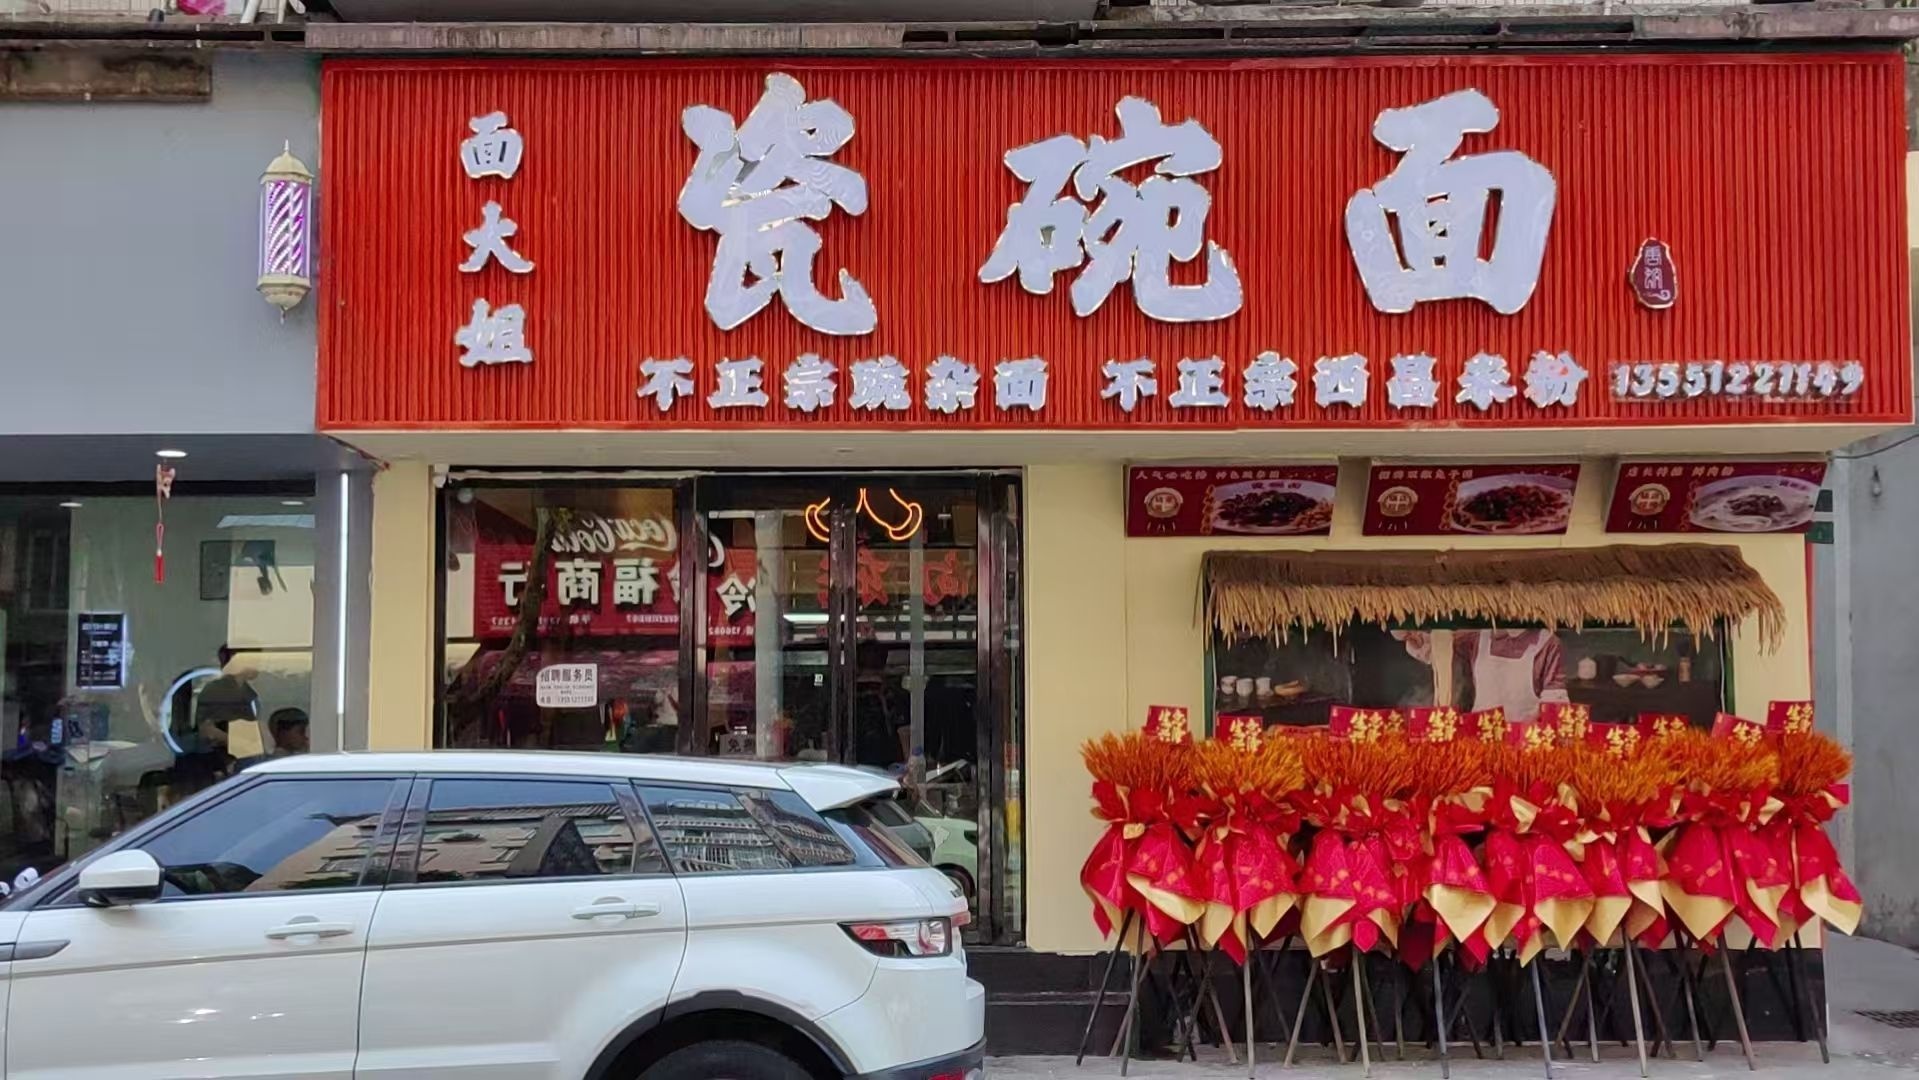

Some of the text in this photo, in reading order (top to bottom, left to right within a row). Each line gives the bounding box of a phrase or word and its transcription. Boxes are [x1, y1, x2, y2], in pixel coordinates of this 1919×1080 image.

[455, 110, 535, 368] 面大姐
[678, 71, 1557, 335] 瓷碗面
[637, 353, 1049, 413] 不正宗豌杂面
[1101, 350, 1590, 412] 不正宗西昌米粉
